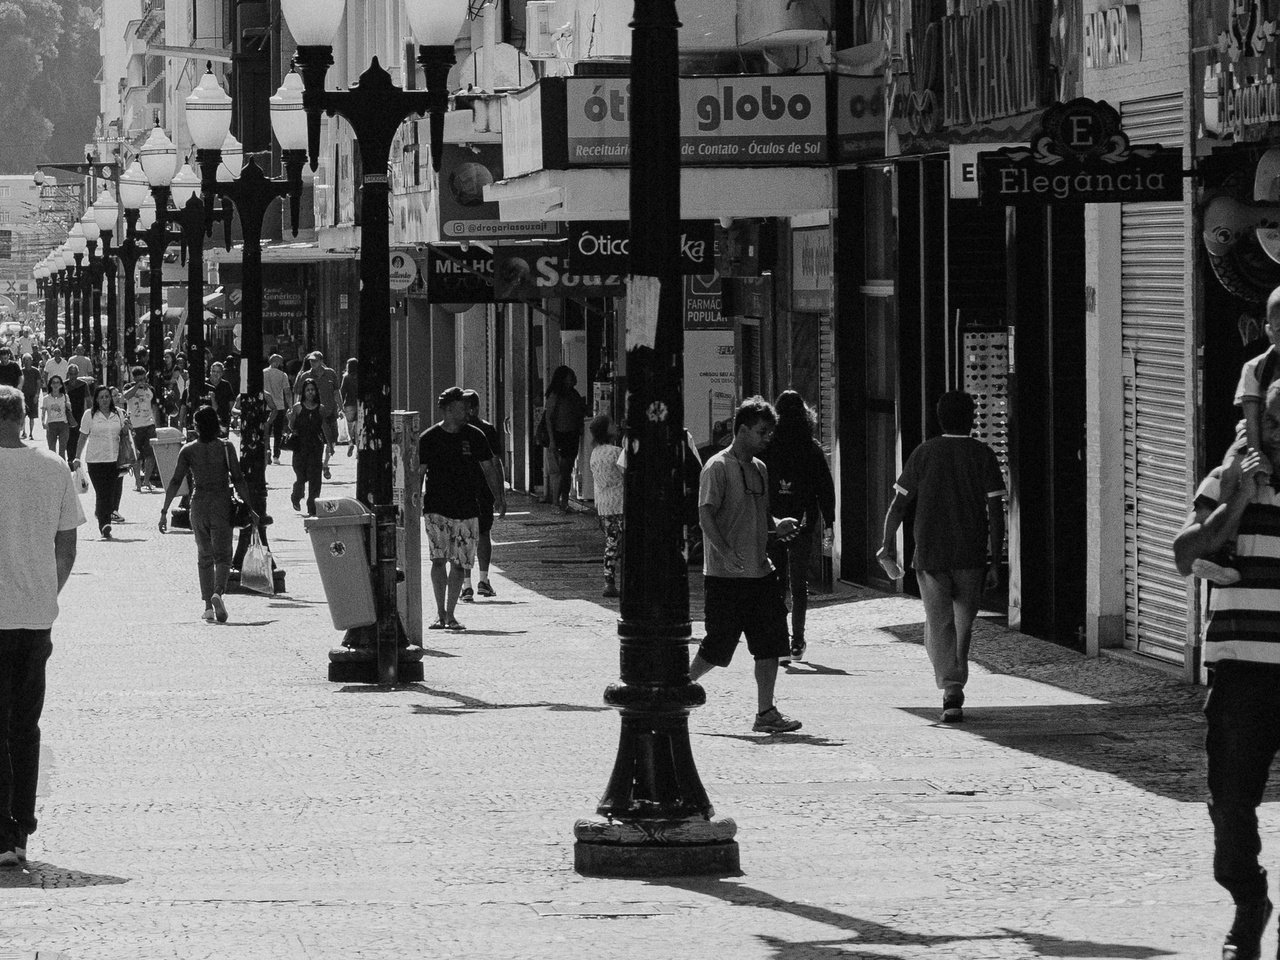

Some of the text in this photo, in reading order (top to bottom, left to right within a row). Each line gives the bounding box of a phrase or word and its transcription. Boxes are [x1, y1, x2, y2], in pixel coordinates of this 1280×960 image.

[696, 85, 811, 132] globo
[1069, 115, 1093, 146] E
[575, 141, 631, 157] Receituári
[681, 143, 695, 155] de
[698, 143, 739, 156] Contato
[748, 141, 786, 155] Óculos
[788, 142, 802, 154] de
[804, 142, 821, 154] Sol
[998, 167, 1166, 199] Elegância
[535, 256, 621, 287] Souz
